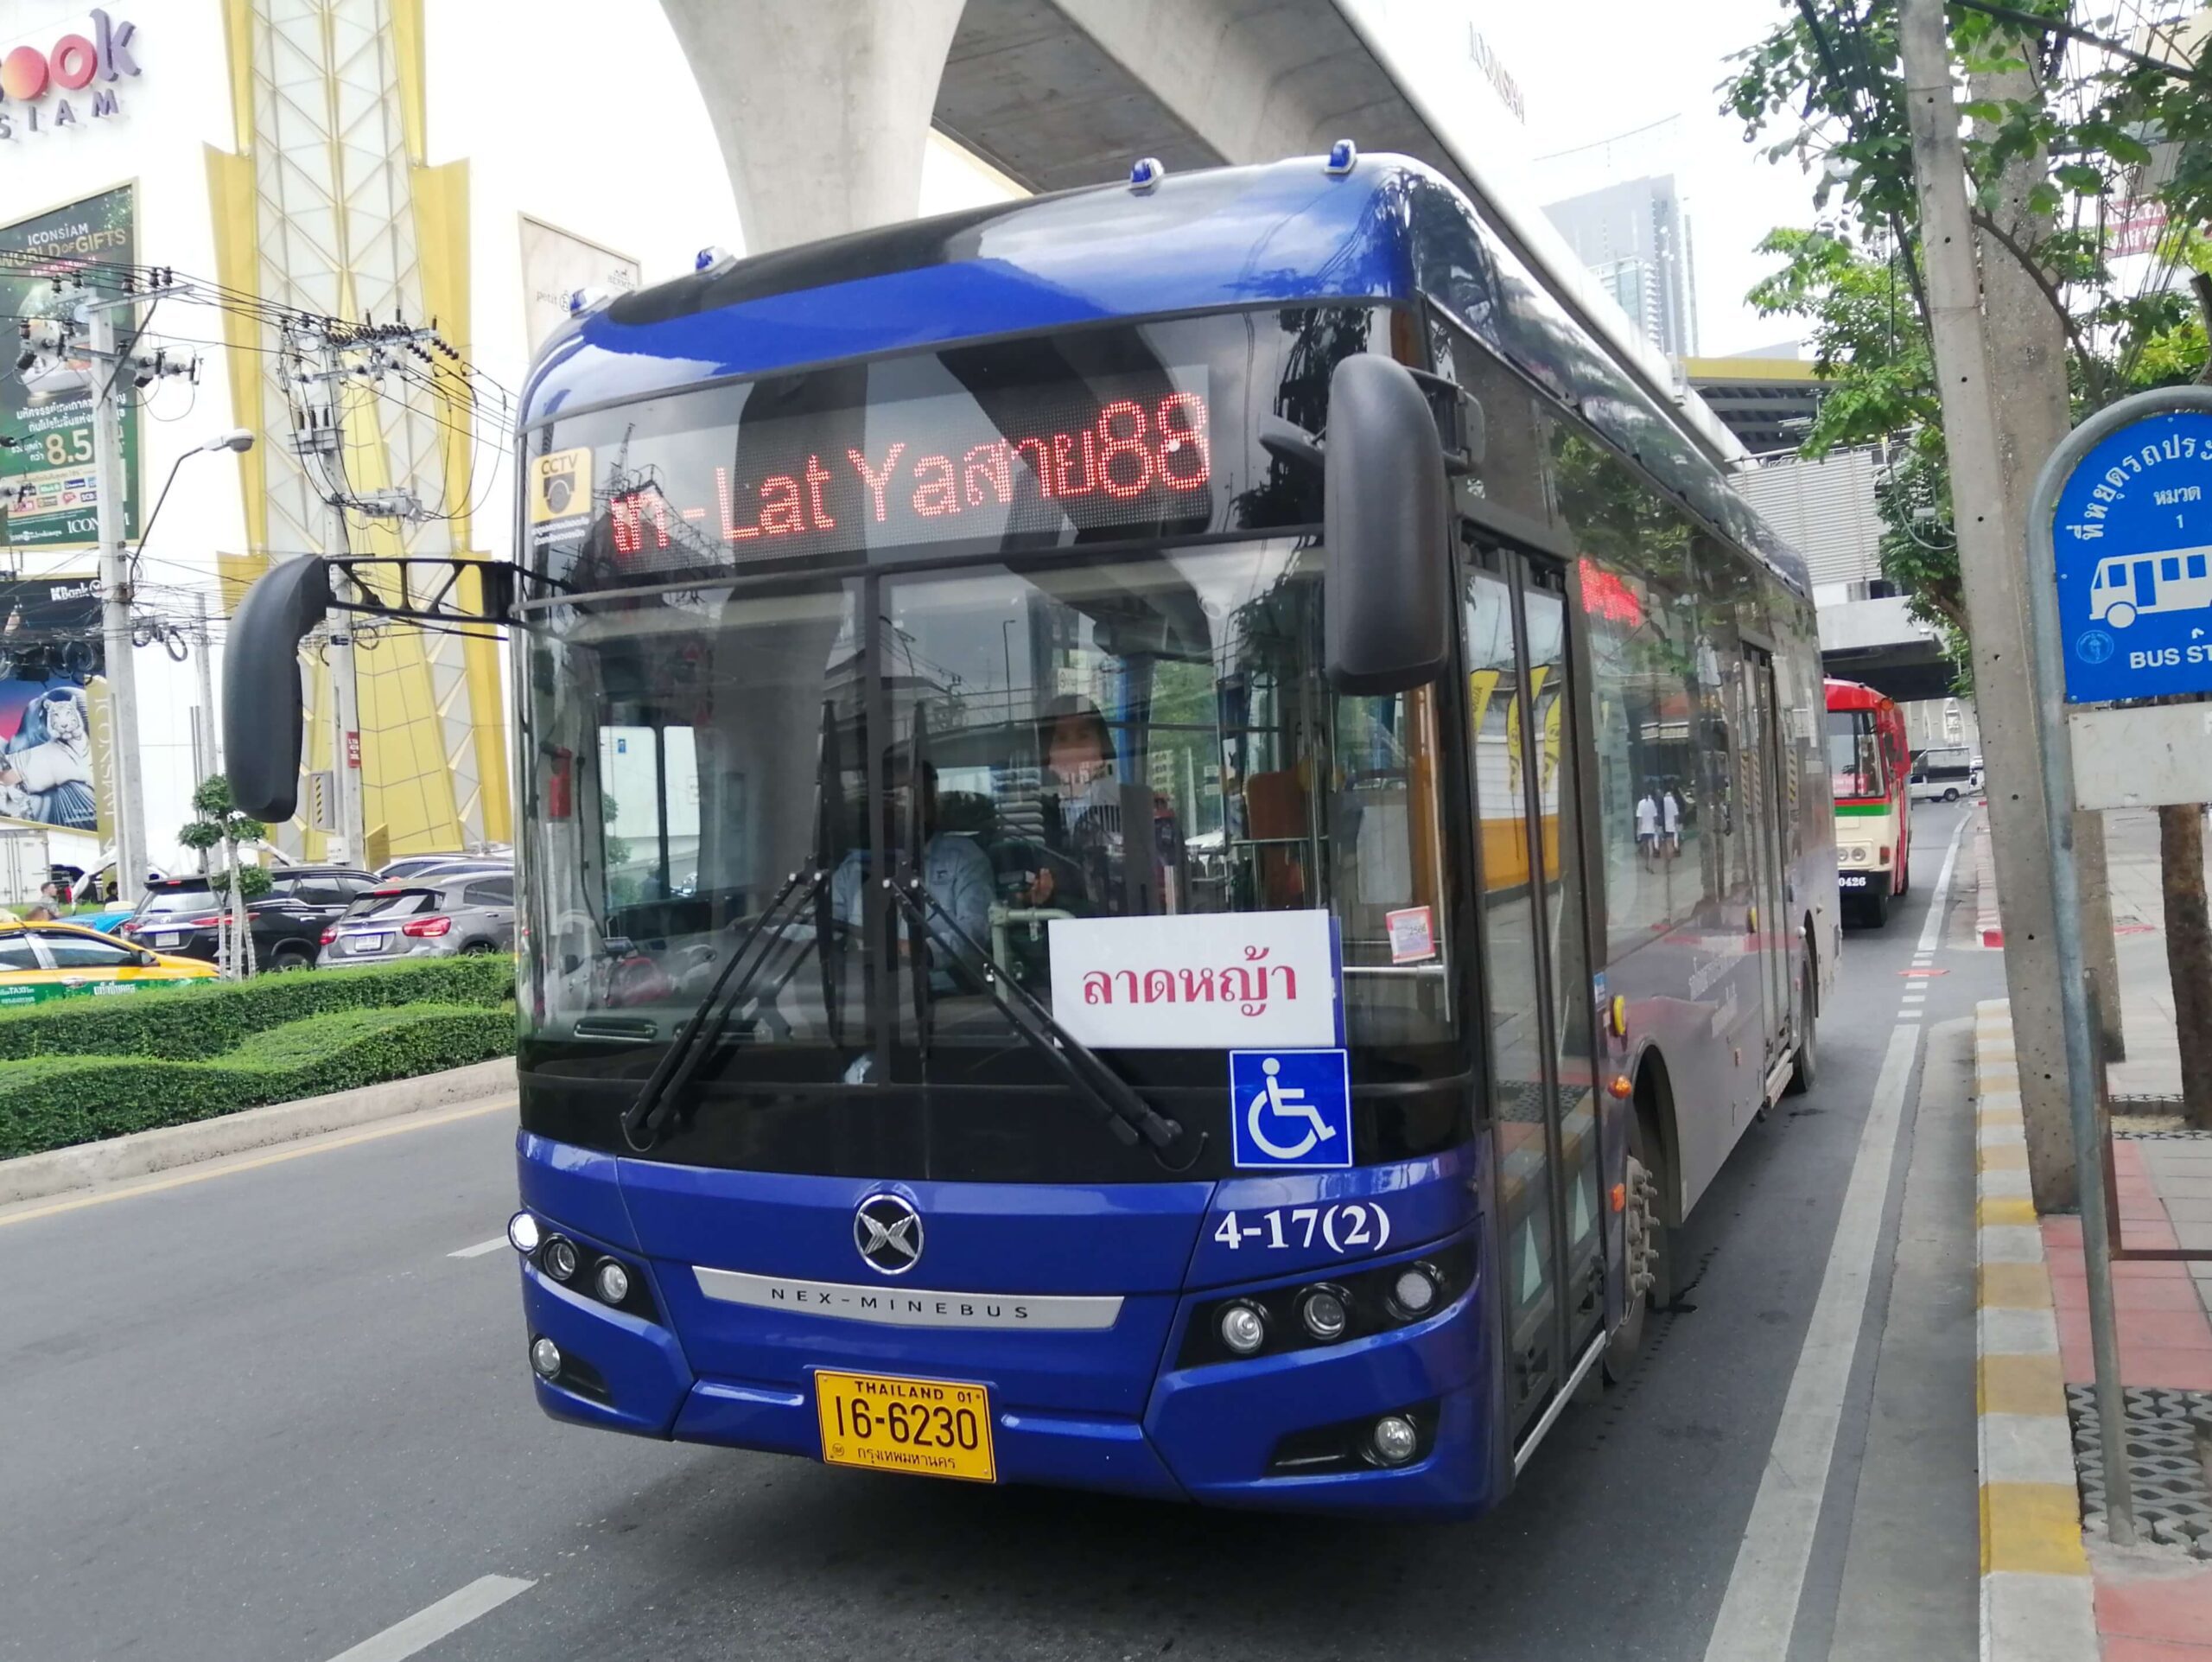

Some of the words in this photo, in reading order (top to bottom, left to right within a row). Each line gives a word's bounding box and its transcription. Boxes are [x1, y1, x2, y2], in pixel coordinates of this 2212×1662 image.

[75, 228, 126, 253] GIFTS
[46, 429, 92, 465] 8.5
[541, 453, 579, 475] CCTV
[2153, 486, 2202, 506] หมวด
[2176, 514, 2183, 528] 1
[50, 582, 90, 602] KBank
[2129, 647, 2181, 669] BUS
[1082, 945, 1298, 1017] ลาดหญ้า
[1214, 1201, 1391, 1254] 4-17(2)
[771, 1288, 1028, 1319] NEX-MINEBUS
[854, 1381, 944, 1400] THAILAND
[957, 1391, 972, 1404] 01
[835, 1395, 979, 1451] 16-6230
[856, 1447, 957, 1469] กรุงเทพมหานคร
